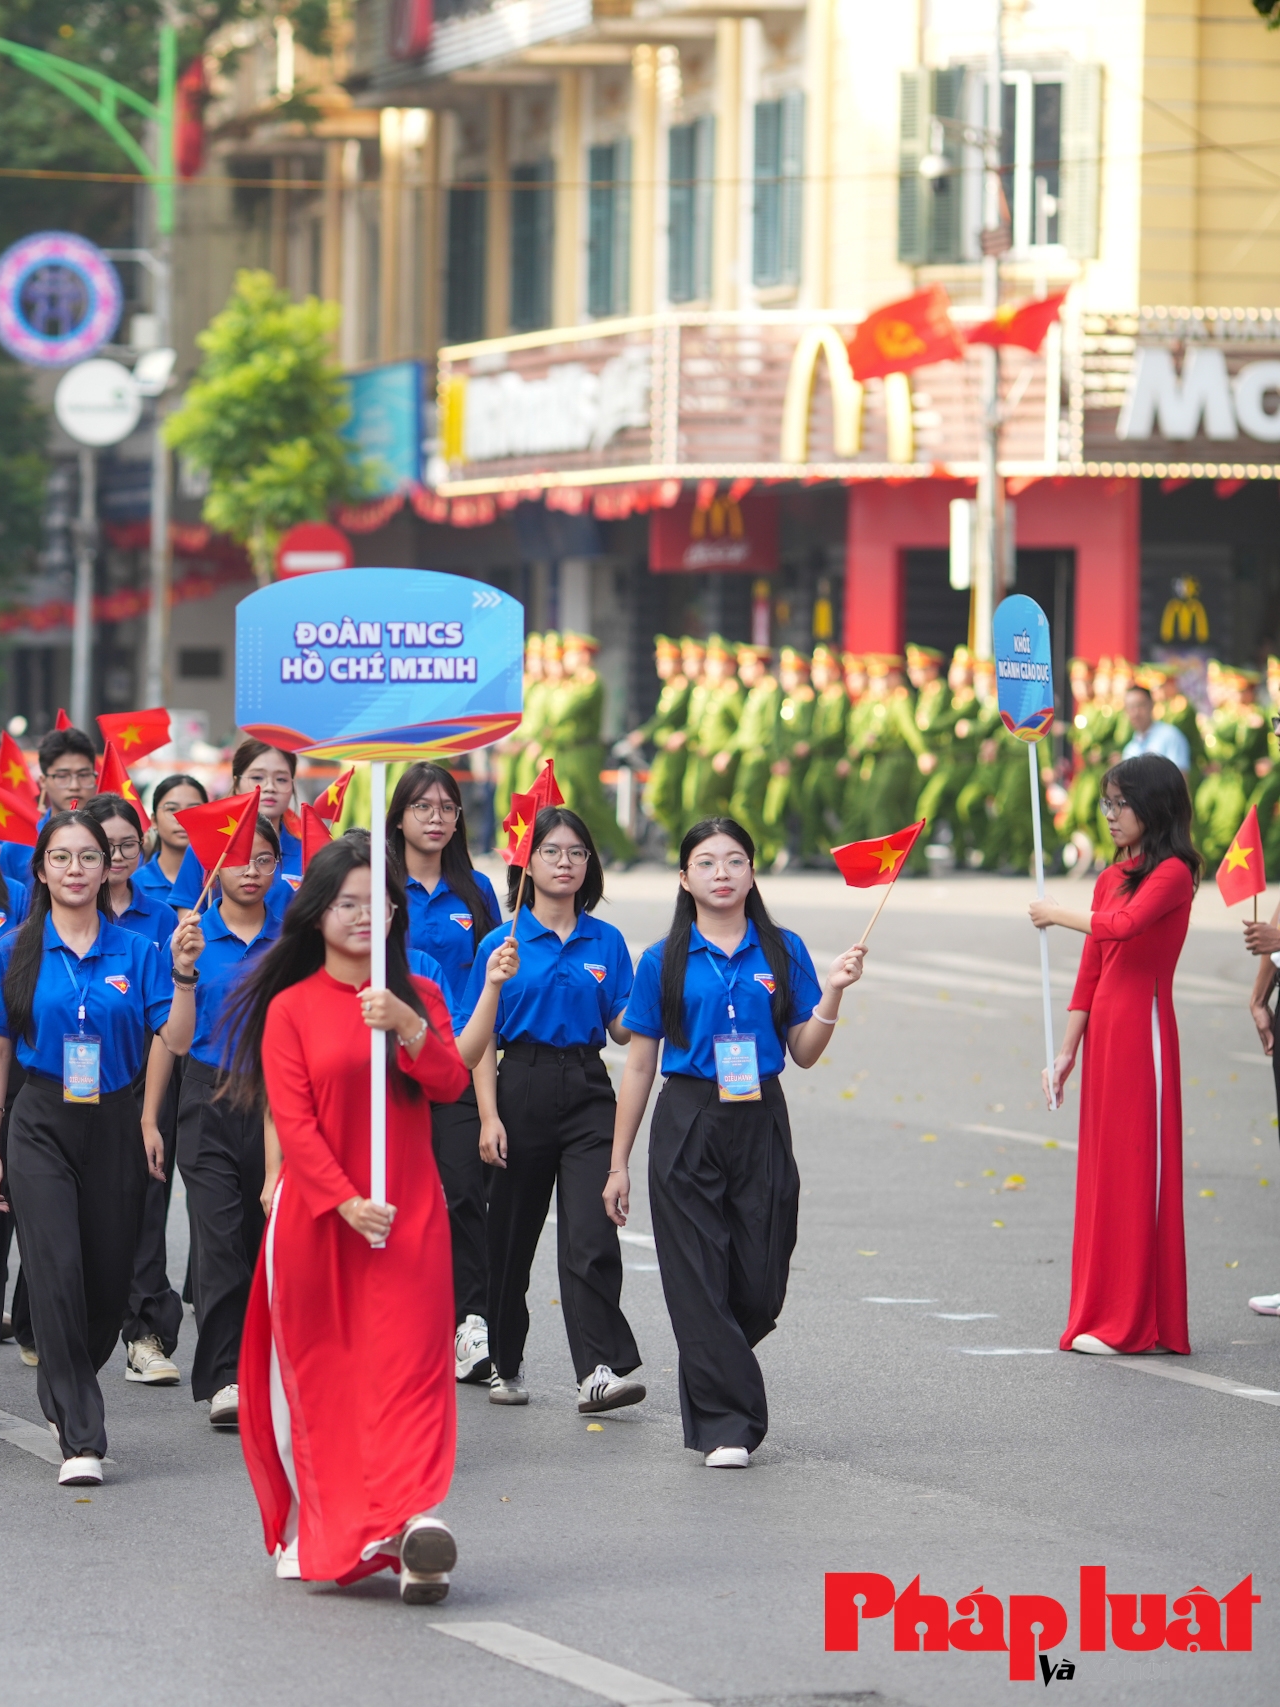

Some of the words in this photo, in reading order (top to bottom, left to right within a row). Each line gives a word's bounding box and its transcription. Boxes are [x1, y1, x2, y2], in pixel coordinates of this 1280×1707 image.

[295, 615, 382, 647] ĐOÀN
[386, 621, 464, 647] TNCS
[1013, 629, 1031, 654] KHỐI
[281, 648, 325, 683] HỒ
[330, 651, 386, 683] CHÍ
[390, 657, 477, 683] MINH
[998, 656, 1021, 680] NGÀNH
[1021, 658, 1036, 682] GIÁO
[1036, 663, 1050, 687] DỤC
